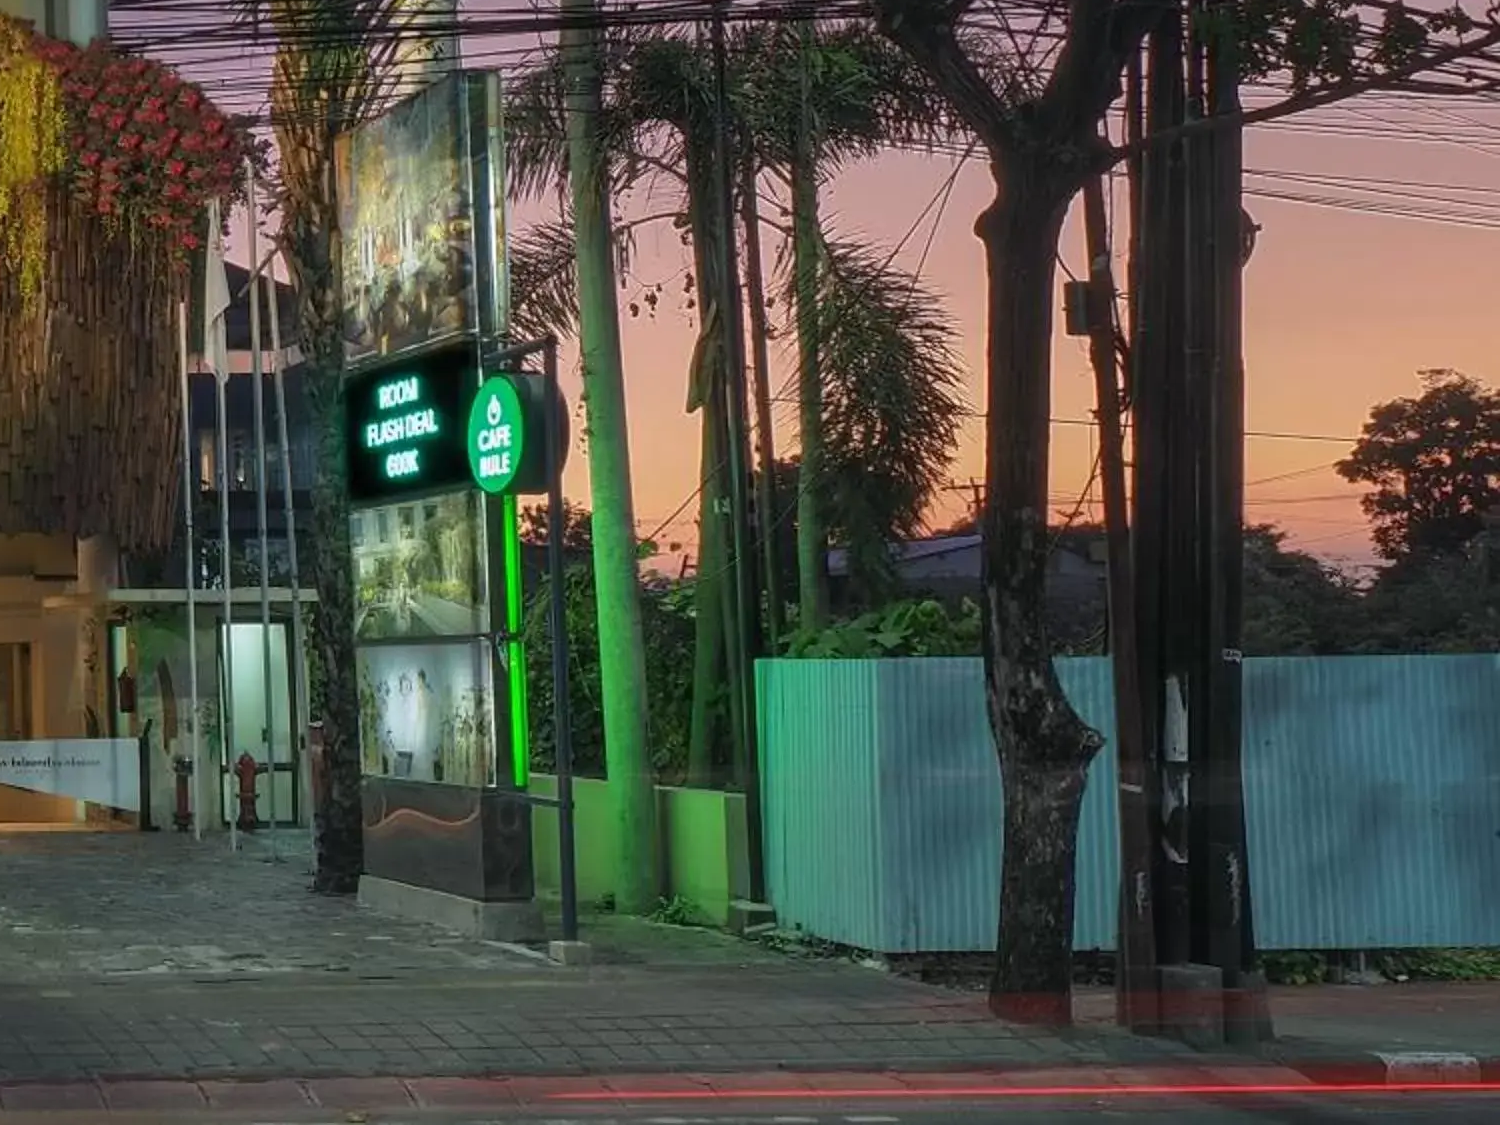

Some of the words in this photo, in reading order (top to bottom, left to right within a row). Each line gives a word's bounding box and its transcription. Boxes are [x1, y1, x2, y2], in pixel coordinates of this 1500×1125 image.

[378, 376, 419, 410] ROOM
[367, 418, 405, 447] FLASH
[406, 408, 439, 437] DEAL
[477, 424, 512, 452] CAFE
[479, 452, 511, 478] BULE
